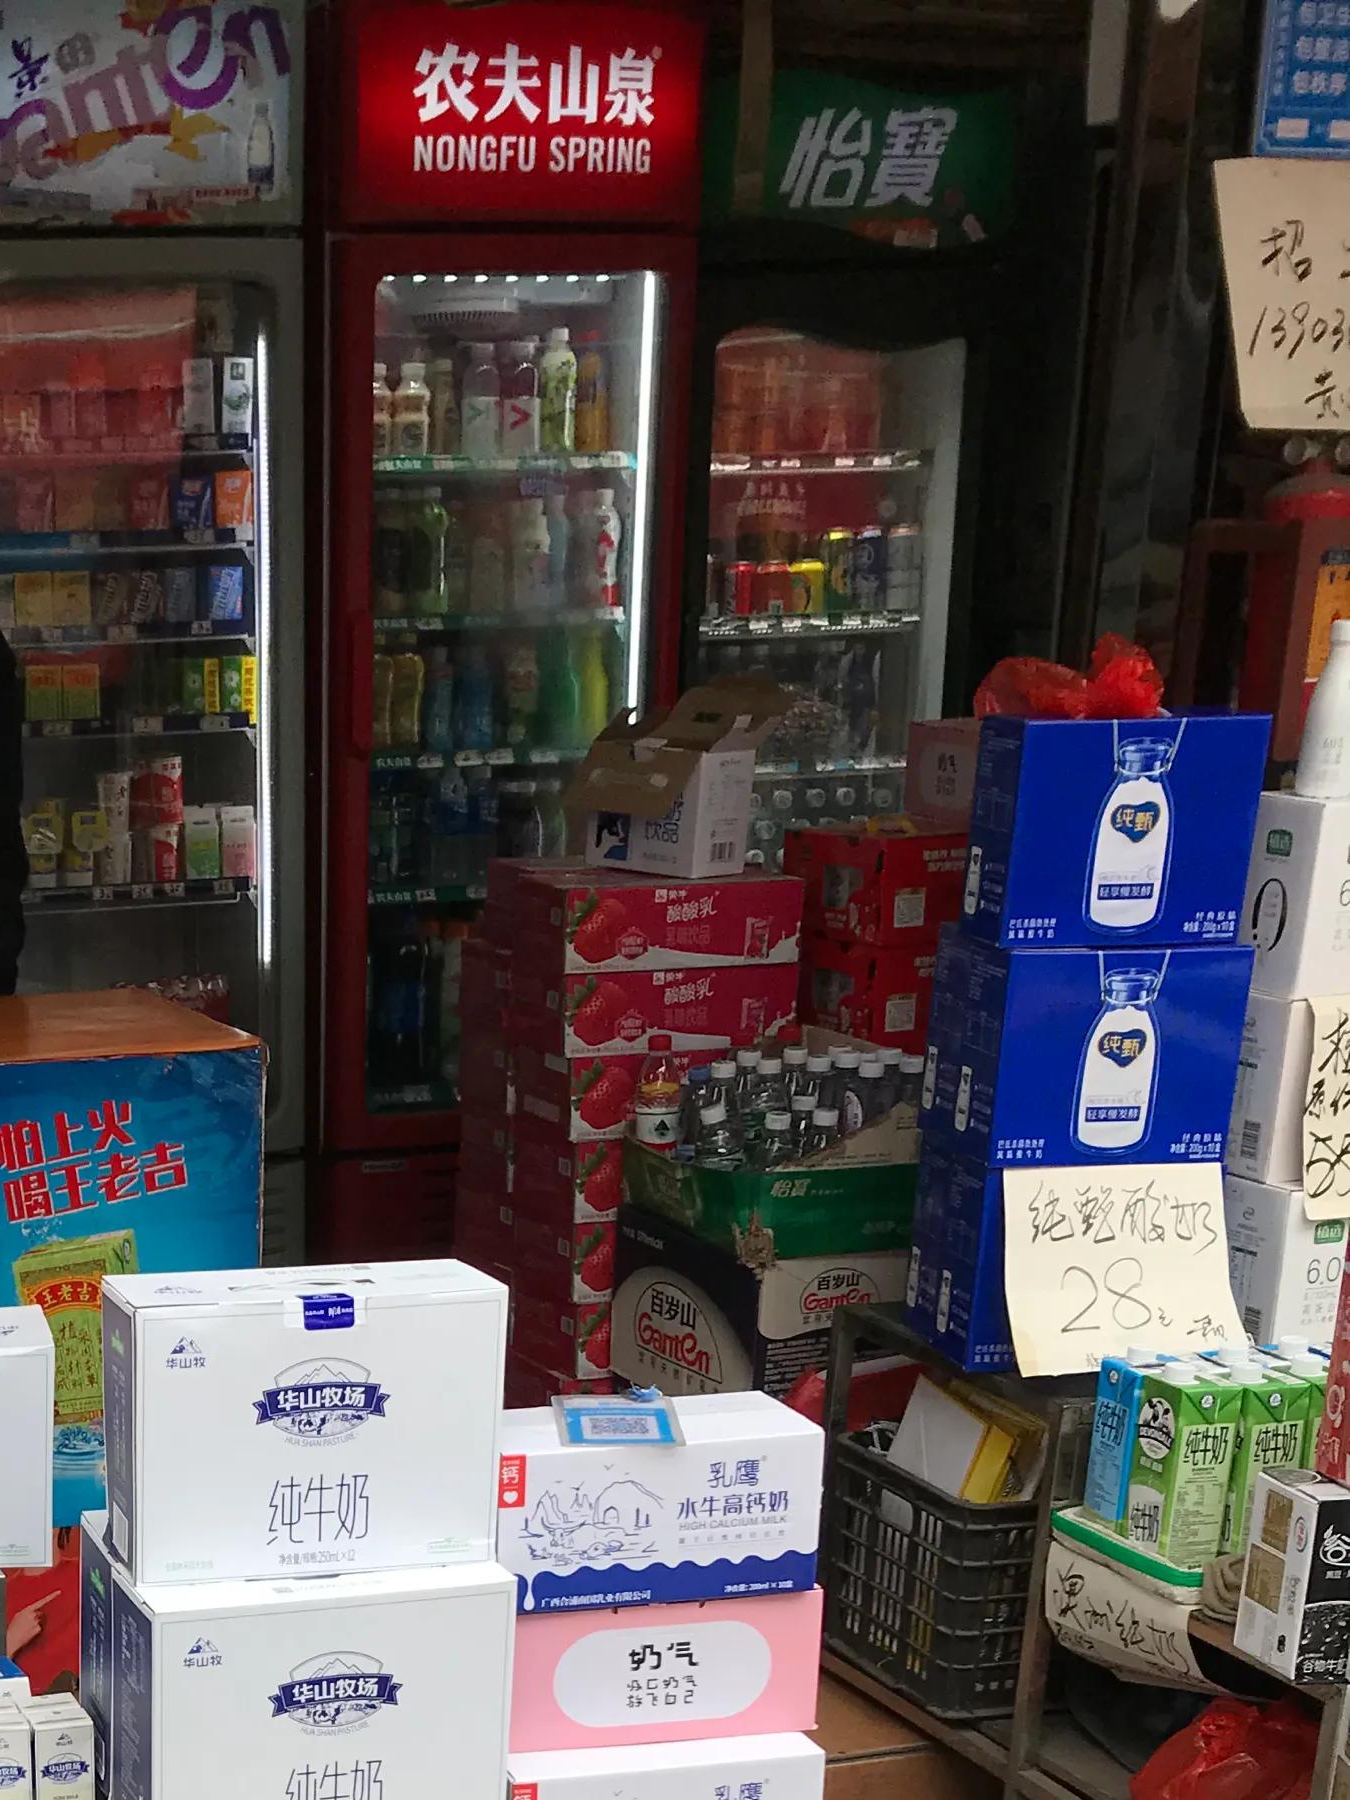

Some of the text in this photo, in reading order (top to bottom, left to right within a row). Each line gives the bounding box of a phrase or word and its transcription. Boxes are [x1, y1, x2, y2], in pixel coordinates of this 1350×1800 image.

[412, 43, 654, 126] 农夫山泉
[412, 135, 651, 174] NONGFU SPRING
[778, 105, 957, 209] 怡寶
[1114, 806, 1156, 833] 纯甄
[666, 894, 718, 923] 酸酸乳
[663, 977, 715, 1005] 酸酸乳
[1101, 1034, 1141, 1059] 纯甄
[2, 1139, 188, 1227] 喝王老吉
[817, 1272, 861, 1291] 百岁山
[1306, 1256, 1342, 1286] 6.0
[41, 1282, 92, 1308] 王老吉
[650, 1288, 697, 1331] 百岁山
[638, 1311, 711, 1376] Ganten
[165, 1356, 207, 1369] 华山牧
[276, 1386, 367, 1410] 华山牧场
[1182, 1425, 1230, 1465] 纯牛奶
[1253, 1422, 1299, 1466] 纯牛奶
[501, 1467, 519, 1485] 钙
[266, 1473, 370, 1546] 纯牛奶
[676, 1491, 790, 1521] 水牛高钙奶
[678, 1515, 787, 1532] HIGH CALCIUM MILK
[1129, 1502, 1160, 1545] 纯牛奶
[182, 1654, 223, 1669] 华山牧
[628, 1641, 699, 1671] 奶气
[291, 1677, 379, 1703] 华山牧场
